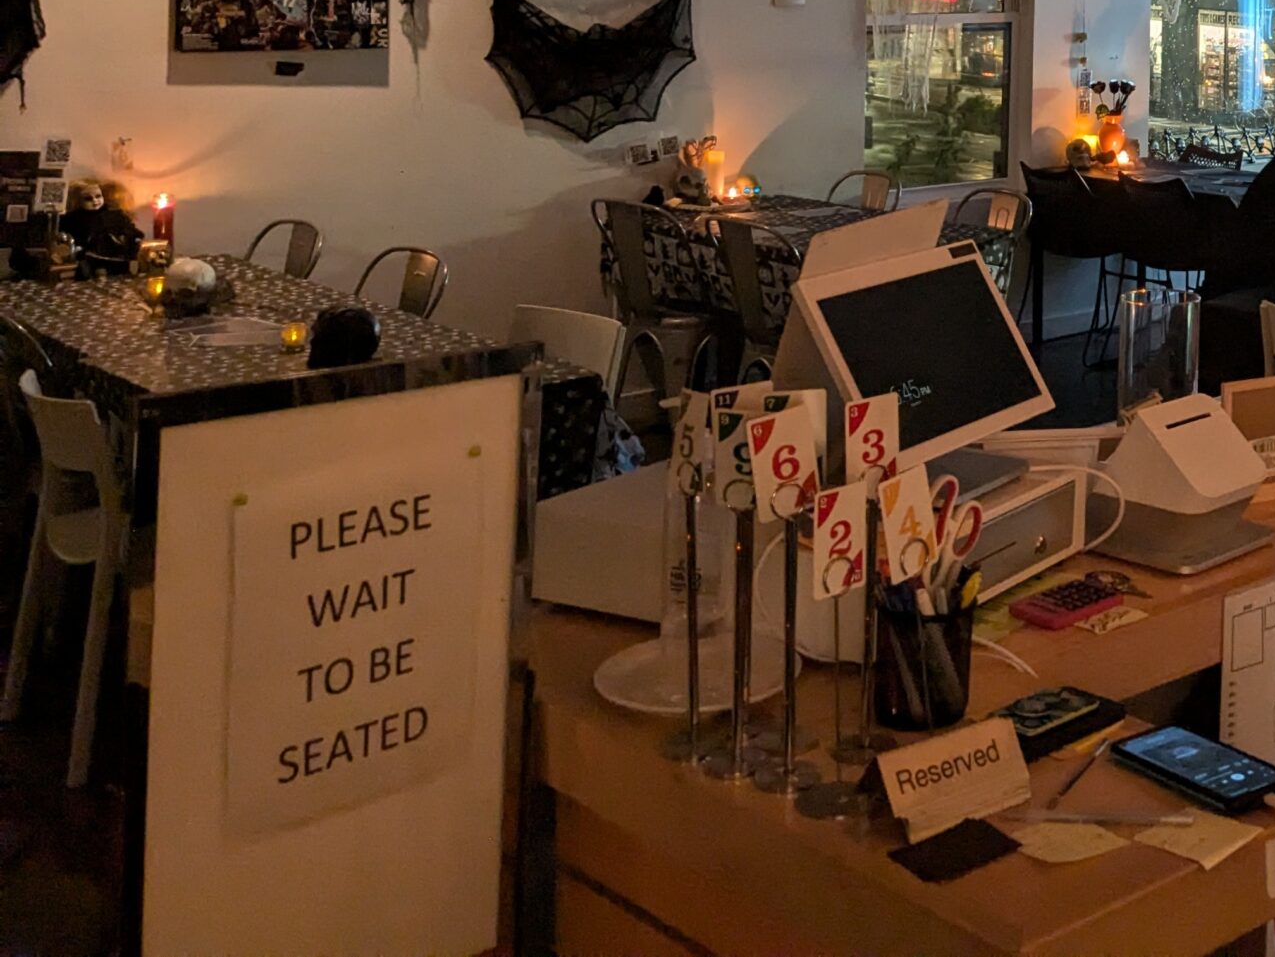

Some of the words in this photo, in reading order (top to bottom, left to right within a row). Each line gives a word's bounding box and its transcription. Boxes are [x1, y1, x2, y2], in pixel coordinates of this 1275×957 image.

[717, 395, 731, 409] 11
[766, 397, 776, 411] 7
[849, 406, 859, 418] 3
[679, 424, 693, 459] 5
[862, 429, 886, 464] 3
[772, 445, 800, 481] 6
[290, 493, 432, 559] PLEASE
[829, 520, 852, 558] 2
[898, 505, 923, 538] 4
[306, 569, 416, 628] WAIT
[297, 658, 355, 704] TO
[369, 639, 415, 684] BE
[277, 706, 429, 784] SEATED
[895, 739, 1001, 795] Reserved
